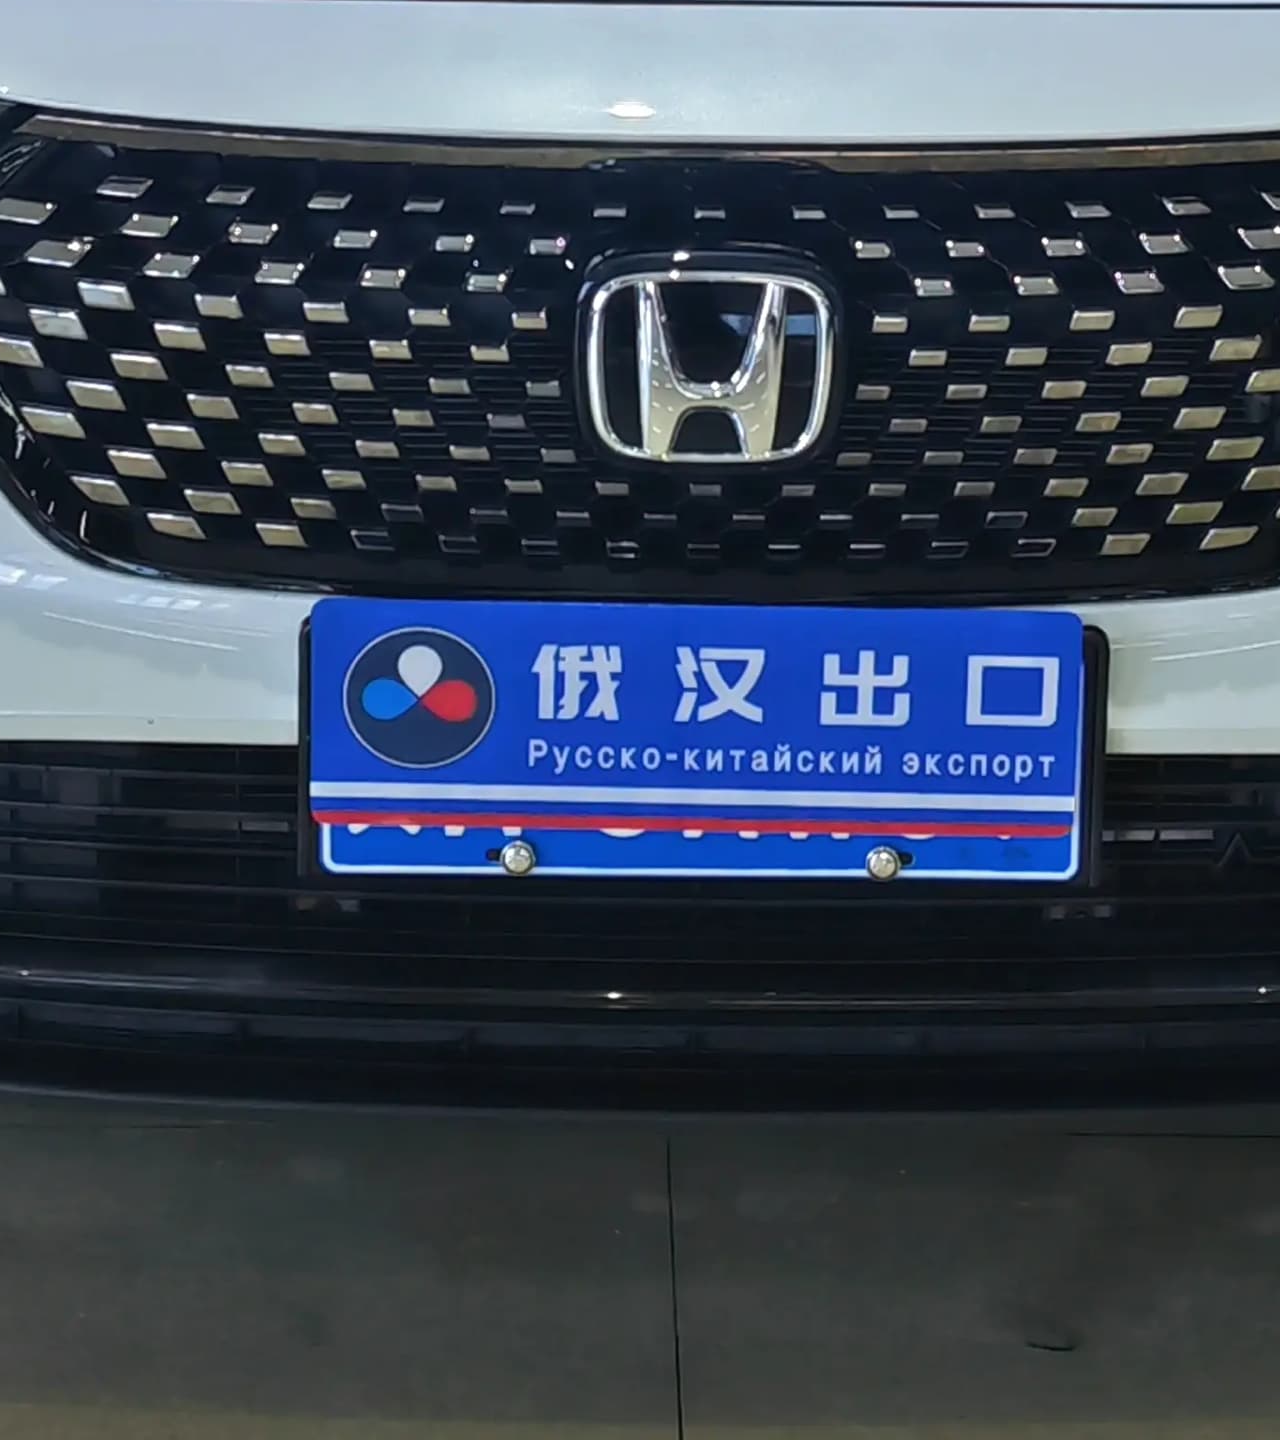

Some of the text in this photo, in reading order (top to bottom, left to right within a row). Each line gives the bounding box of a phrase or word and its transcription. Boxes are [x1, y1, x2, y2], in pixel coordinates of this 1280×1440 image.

[532, 645, 1060, 727] 俄汉出口
[528, 738, 1056, 782] Русско-китайский экспорт
